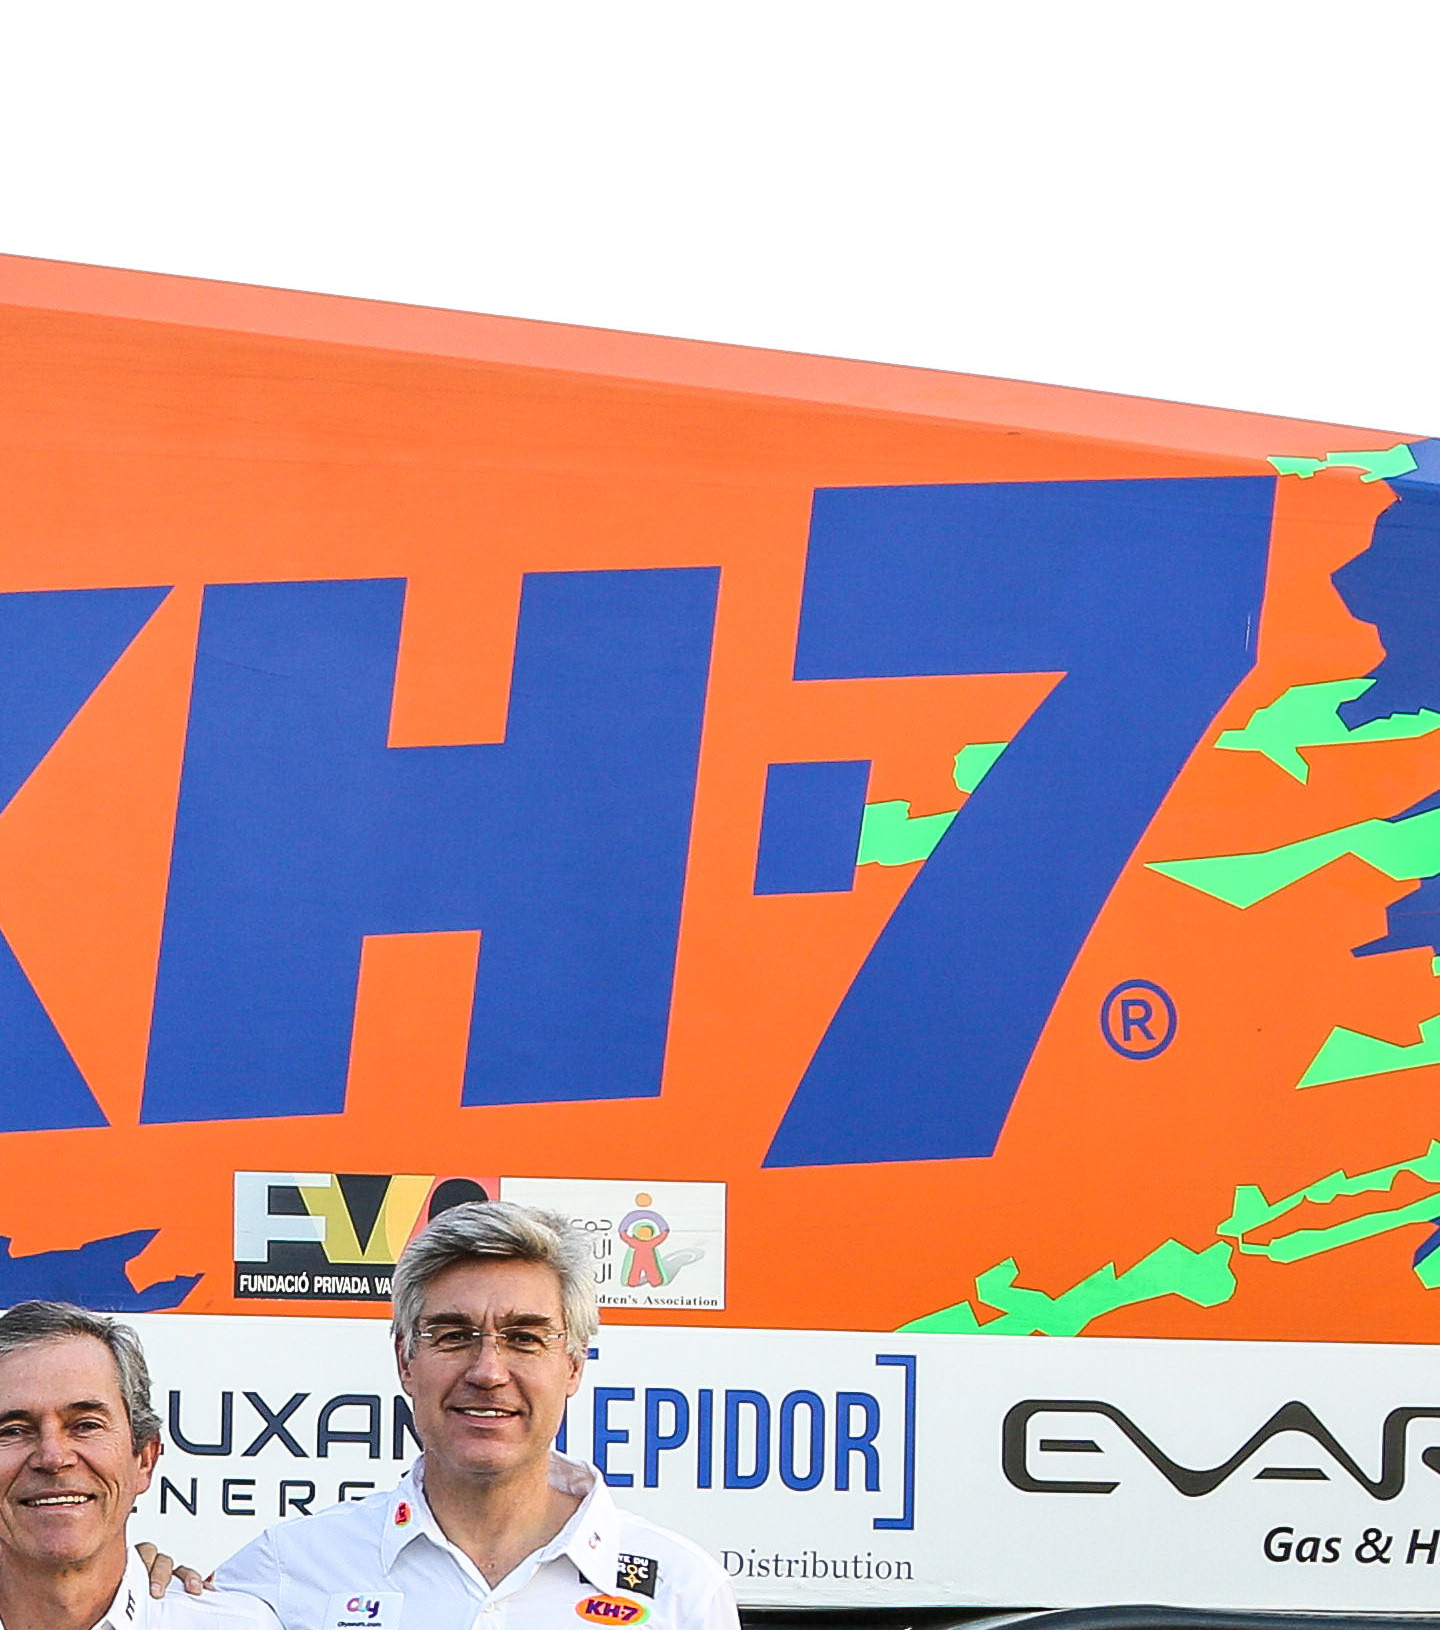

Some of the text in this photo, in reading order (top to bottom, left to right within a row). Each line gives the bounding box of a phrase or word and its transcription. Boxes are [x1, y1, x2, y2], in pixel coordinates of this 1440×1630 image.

[239, 1271, 310, 1294] FUNDACIÓ
[313, 1275, 371, 1295] PRIVADA
[643, 1296, 719, 1307] Association
[1263, 1526, 1342, 1565] Gas
[1353, 1529, 1392, 1566] &
[719, 1548, 916, 1581] Distribution
